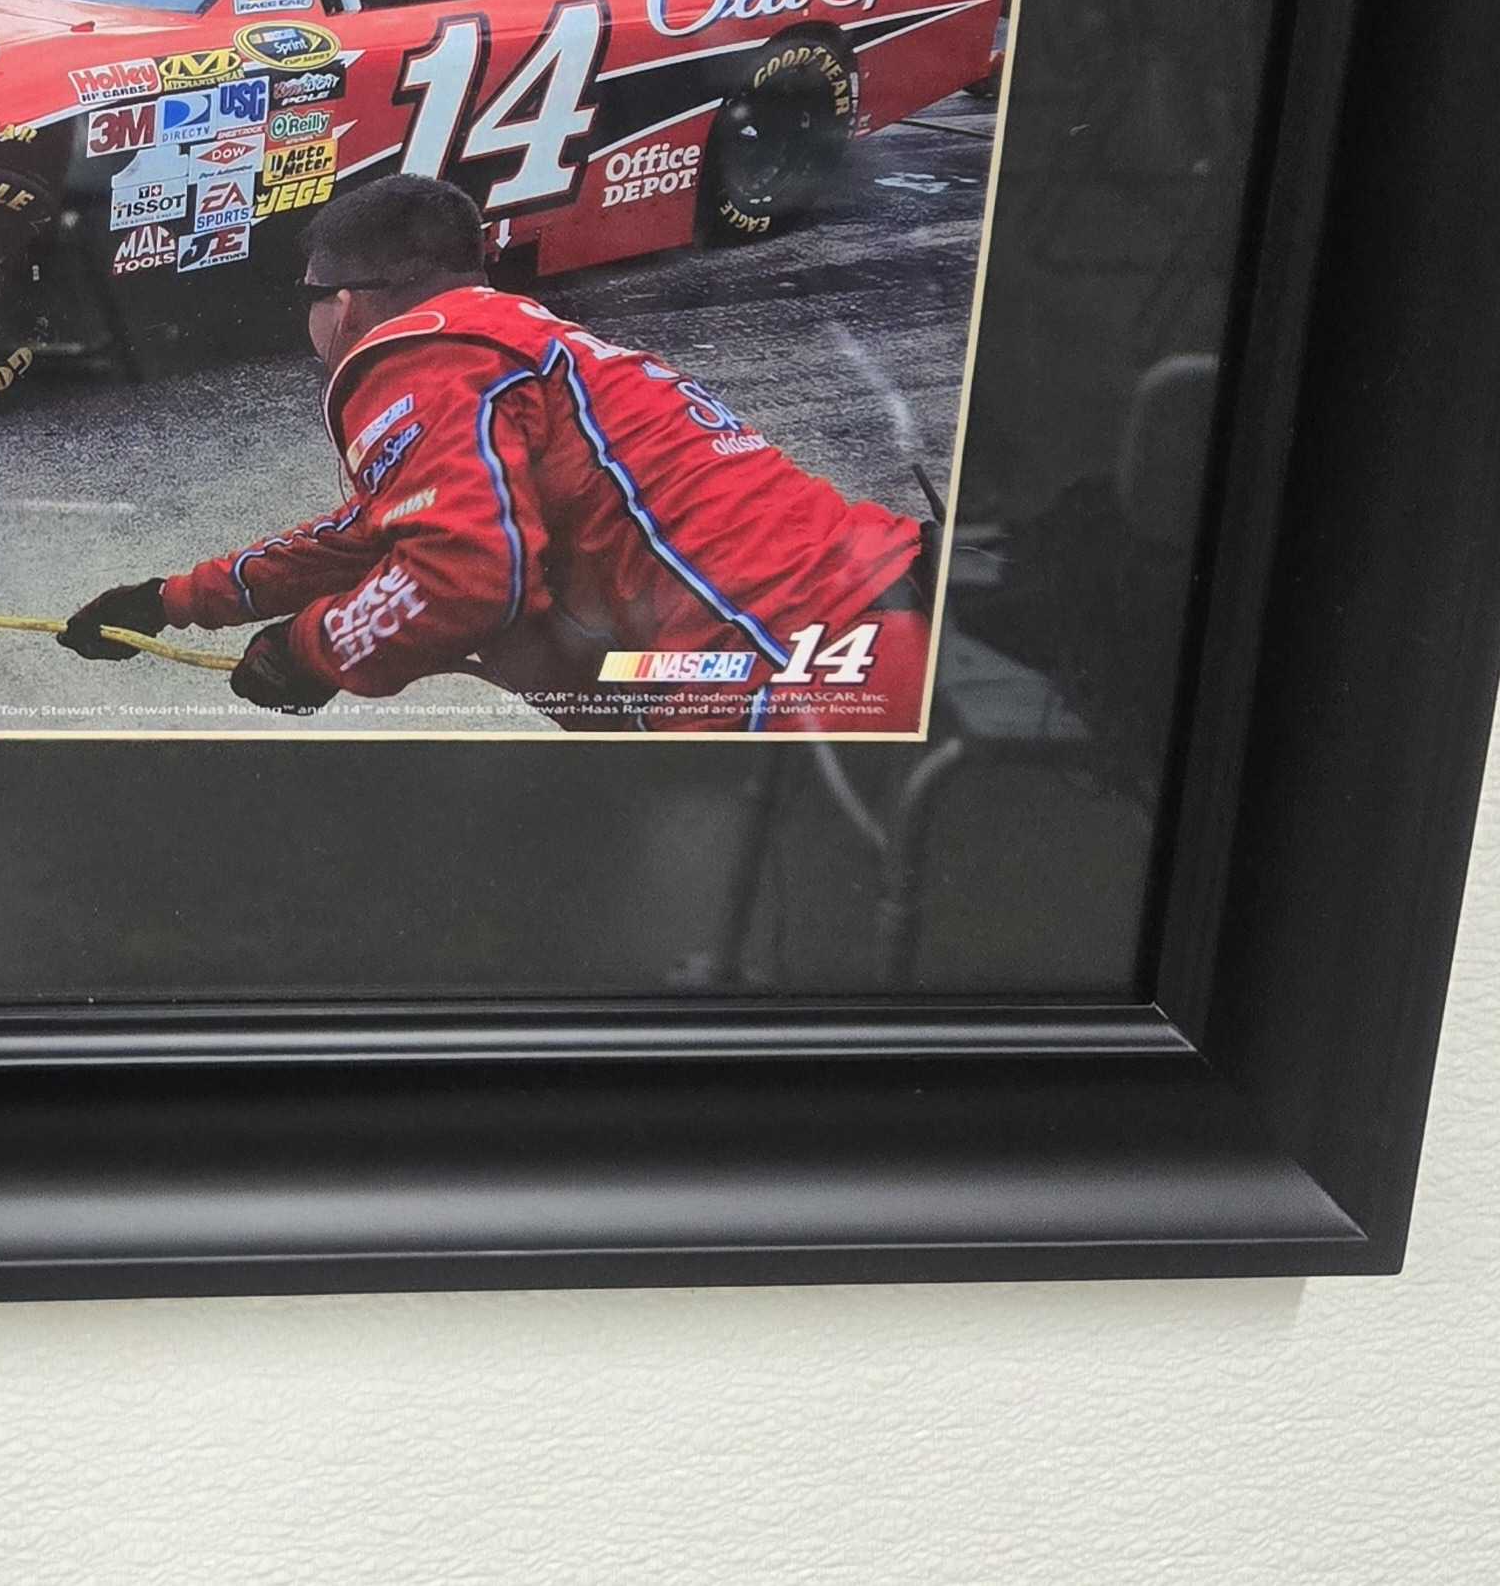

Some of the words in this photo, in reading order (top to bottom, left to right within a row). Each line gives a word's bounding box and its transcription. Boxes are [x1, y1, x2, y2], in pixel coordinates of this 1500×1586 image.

[273, 37, 308, 55] Sprint
[72, 60, 159, 94] Holley
[753, 45, 851, 116] GOODYEAR
[219, 81, 267, 123] USG
[398, 2, 607, 211] 14
[89, 104, 156, 154] 3M
[161, 125, 212, 143] DIRECTV
[271, 112, 331, 138] O'Reilly
[283, 156, 333, 177] Meter
[286, 145, 326, 163] Auto
[604, 143, 701, 184] Office
[199, 181, 249, 214] EA
[255, 174, 336, 216] JEGS
[602, 170, 699, 208] DEPOT
[116, 193, 186, 219] TISSOT
[196, 207, 250, 230] SPORTS
[719, 199, 771, 233] EAGLE
[114, 224, 176, 263] MAC
[113, 252, 177, 274] TOOLS
[650, 653, 749, 680] NASCAR
[768, 622, 876, 686] 14
[297, 704, 327, 716] and
[375, 706, 401, 715] are
[403, 704, 488, 715] trademarks
[496, 704, 514, 715] of
[515, 704, 619, 715] Stewart-Haas
[622, 704, 676, 717] Racing
[678, 704, 709, 715] and
[711, 706, 736, 715] are
[780, 704, 825, 715] under
[577, 692, 590, 703] is
[593, 694, 603, 703] a
[606, 692, 686, 705] registered
[688, 692, 767, 703] trademark
[770, 692, 787, 703] of
